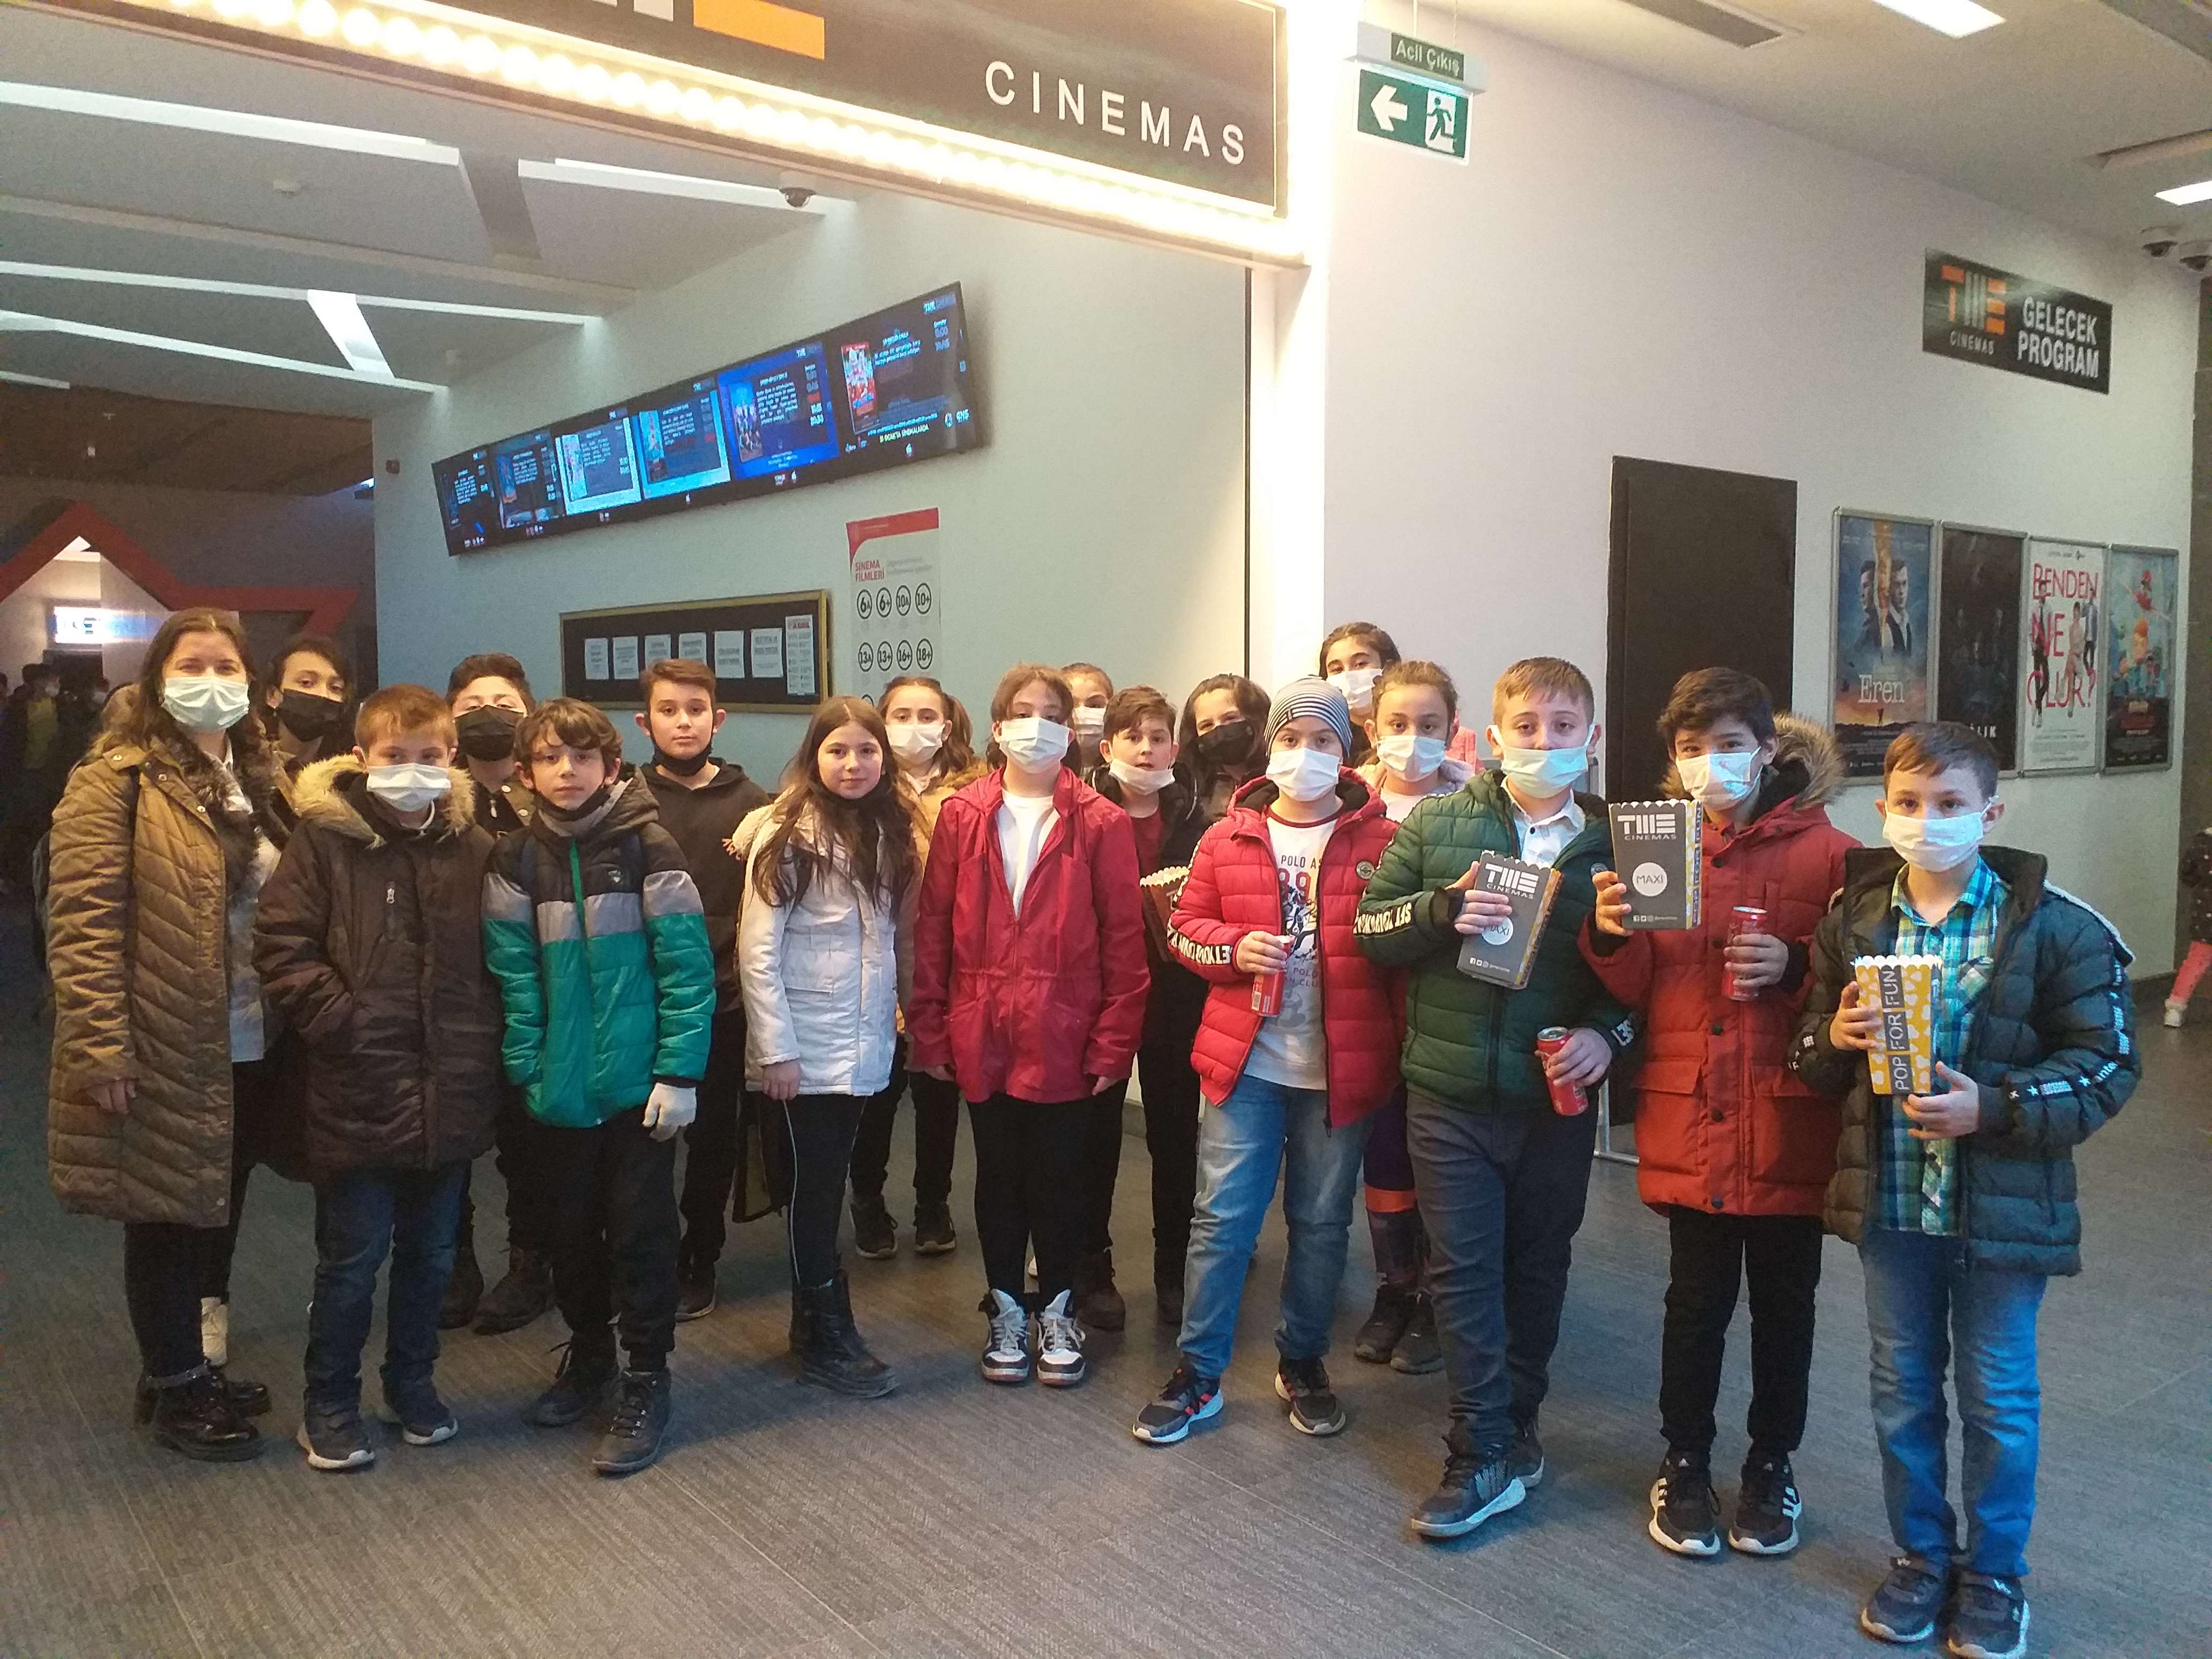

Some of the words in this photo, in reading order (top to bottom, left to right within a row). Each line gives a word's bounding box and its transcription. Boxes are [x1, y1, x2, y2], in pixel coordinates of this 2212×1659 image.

[1396, 39, 1423, 63] Acil
[985, 60, 1245, 166] CINEMAS
[2022, 296, 2097, 346] GELECEK
[1949, 330, 1994, 355] CINEMAS
[2017, 330, 2099, 378] PROGRAM
[2032, 563, 2099, 601] BENDEN
[879, 594, 891, 611] 6+
[917, 593, 930, 606] 10+
[2031, 612, 2066, 657] NE
[879, 651, 891, 663] 13+
[899, 649, 911, 662] 16+
[918, 648, 931, 661] 18+
[1858, 674, 1905, 704] Eren
[1281, 855, 1306, 868] POLO
[1486, 883, 1534, 900] CINEMAS
[1636, 875, 1663, 884] MAXI
[1293, 967, 1318, 980] POLO
[1881, 969, 1901, 1006] FUN
[1887, 1013, 1906, 1050] FOR
[1892, 1057, 1909, 1090] POP
